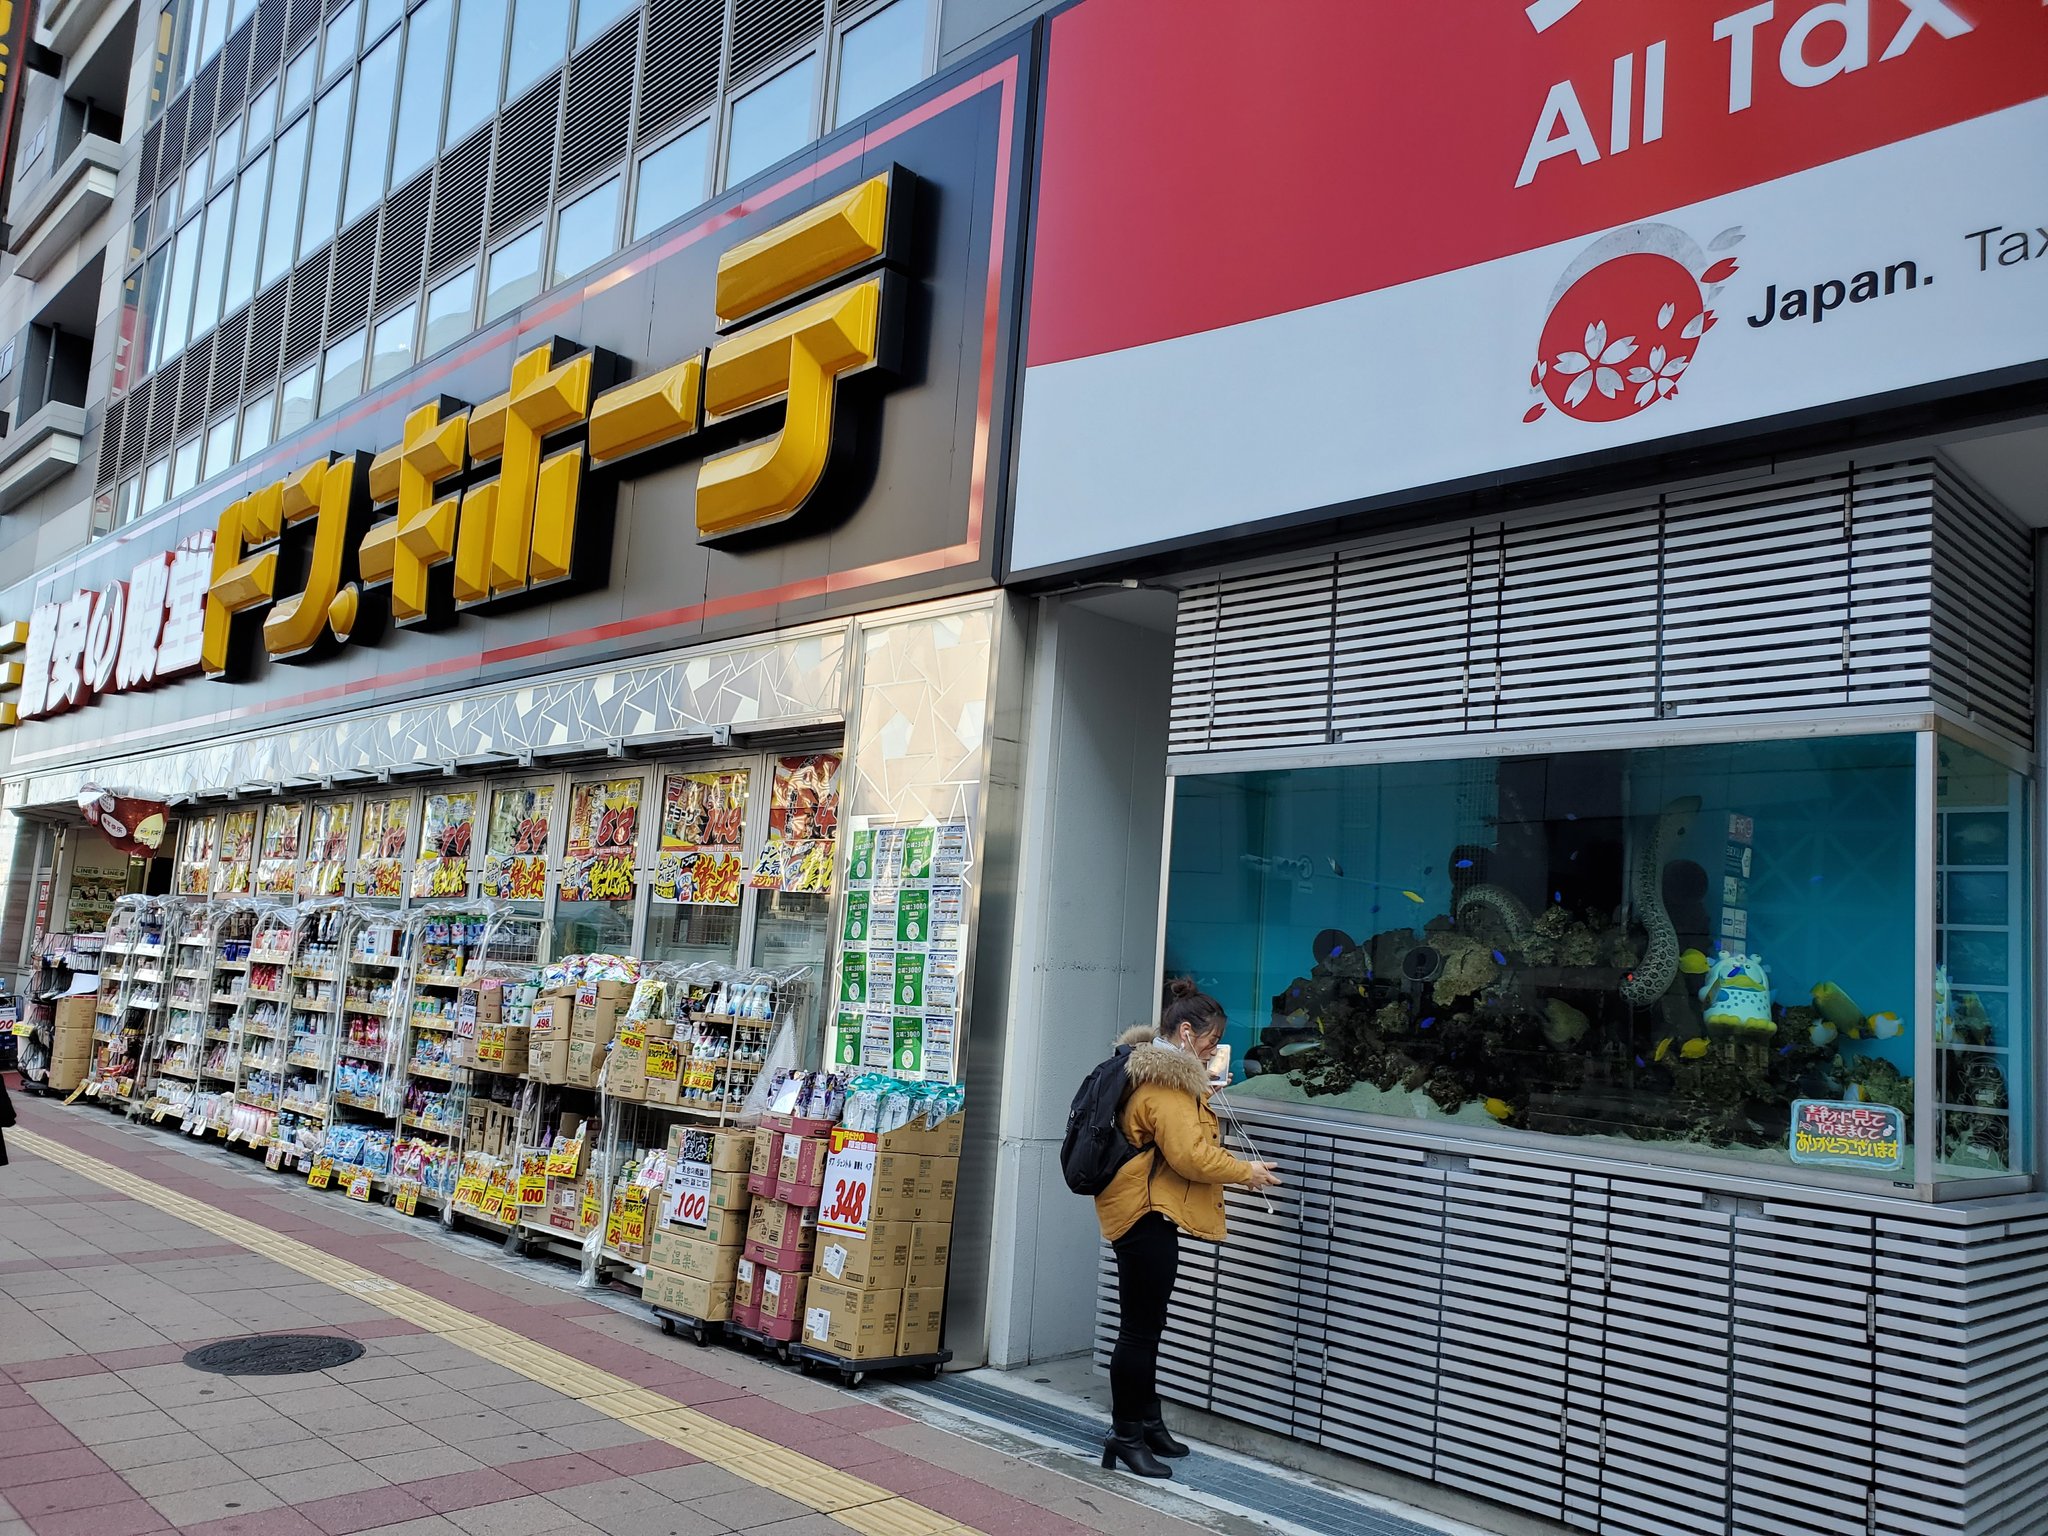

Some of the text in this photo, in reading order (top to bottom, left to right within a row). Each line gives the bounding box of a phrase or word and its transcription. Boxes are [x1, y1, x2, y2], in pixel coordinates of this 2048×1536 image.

[1514, 0, 1978, 188] All Tax
[1747, 261, 1933, 328] Japan.
[597, 806, 636, 846] 68
[579, 994, 594, 1005] 498
[535, 1018, 550, 1029] 498
[623, 1037, 641, 1048] 498
[1805, 1105, 1886, 1127] 静かに見て
[1816, 1122, 1881, 1140] 頂きまして
[1796, 1130, 1899, 1159] ありがとうございます
[311, 1175, 327, 1185] 178
[455, 1187, 471, 1200] 178
[470, 1190, 482, 1204] 178
[522, 1189, 544, 1203] 100
[483, 1197, 500, 1212] 178
[502, 1206, 518, 1221] 178
[625, 1222, 642, 1238] 148
